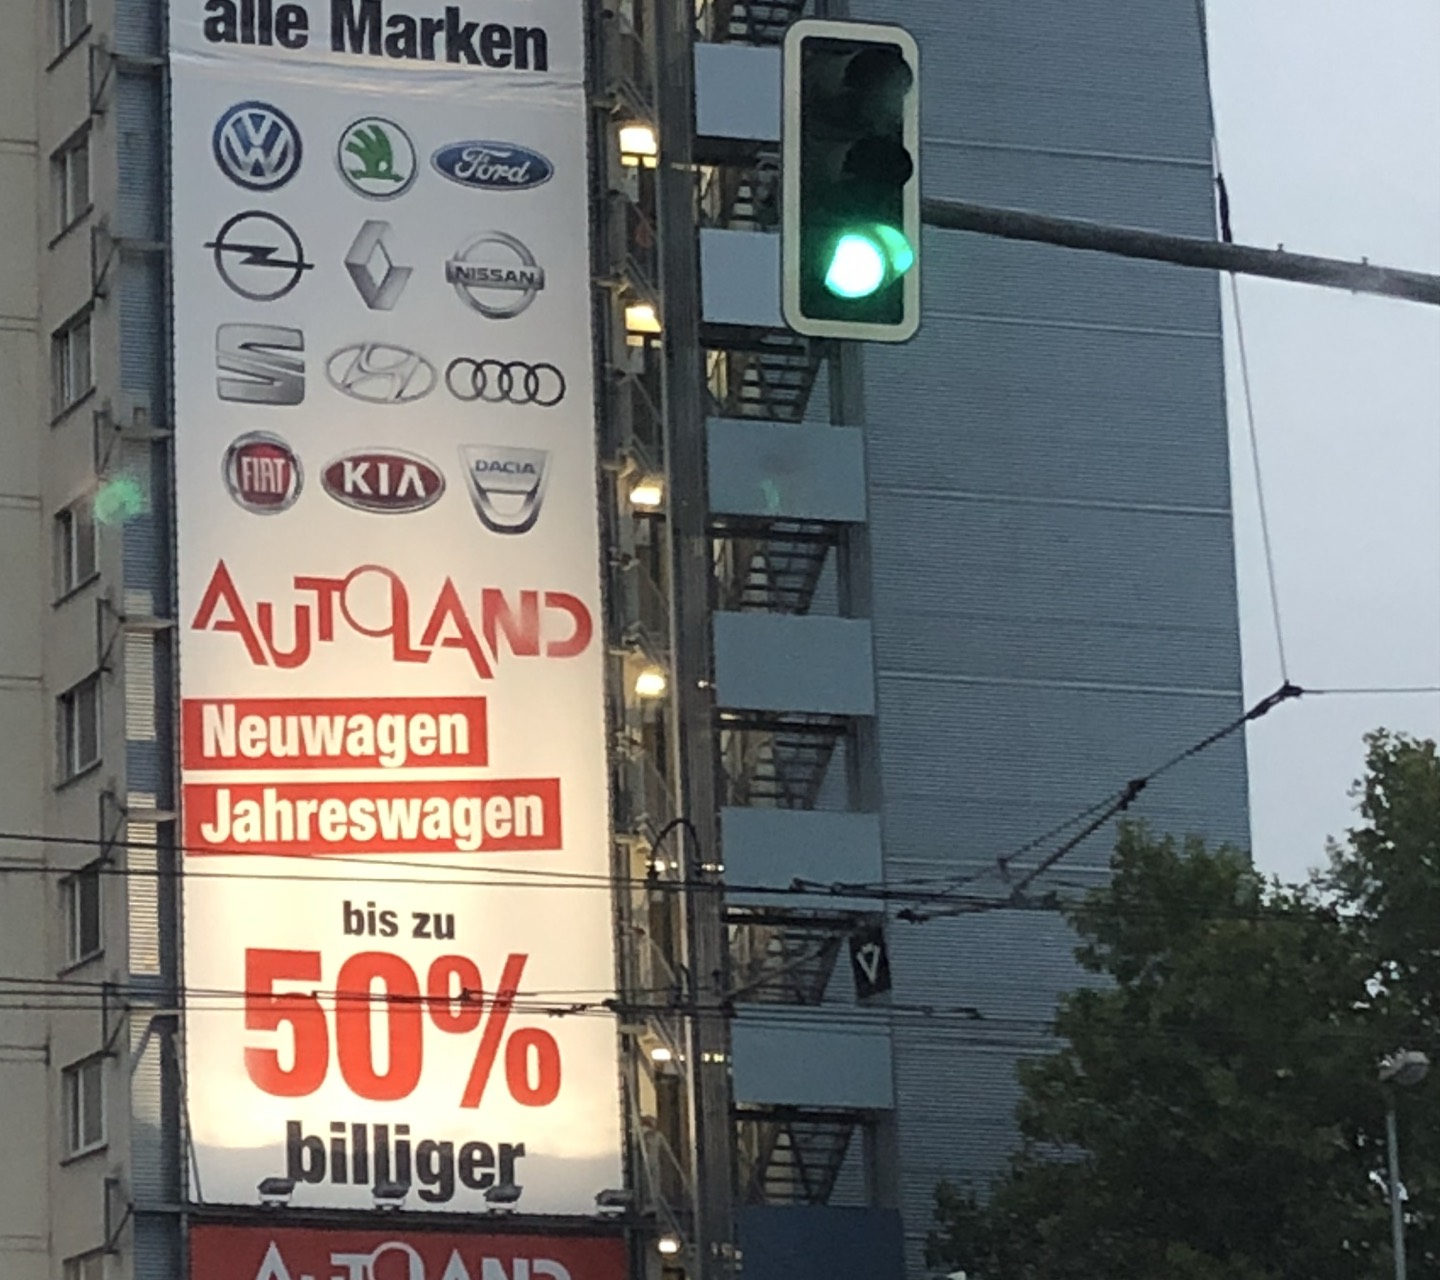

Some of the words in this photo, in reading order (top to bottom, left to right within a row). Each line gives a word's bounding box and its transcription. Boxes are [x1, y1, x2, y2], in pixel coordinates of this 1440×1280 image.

[453, 145, 531, 185] Ford
[454, 265, 536, 285] NISSAN
[241, 455, 289, 494] FIAT
[342, 461, 427, 498] KIA
[474, 458, 537, 476] DACIA
[190, 558, 594, 680] AUTOLAND
[201, 703, 470, 768] Neuwagen
[200, 788, 545, 851] Jahreswagen
[342, 900, 399, 938] bis
[411, 909, 456, 941] zu
[243, 947, 562, 1109] 50%
[286, 1120, 526, 1204] billiger
